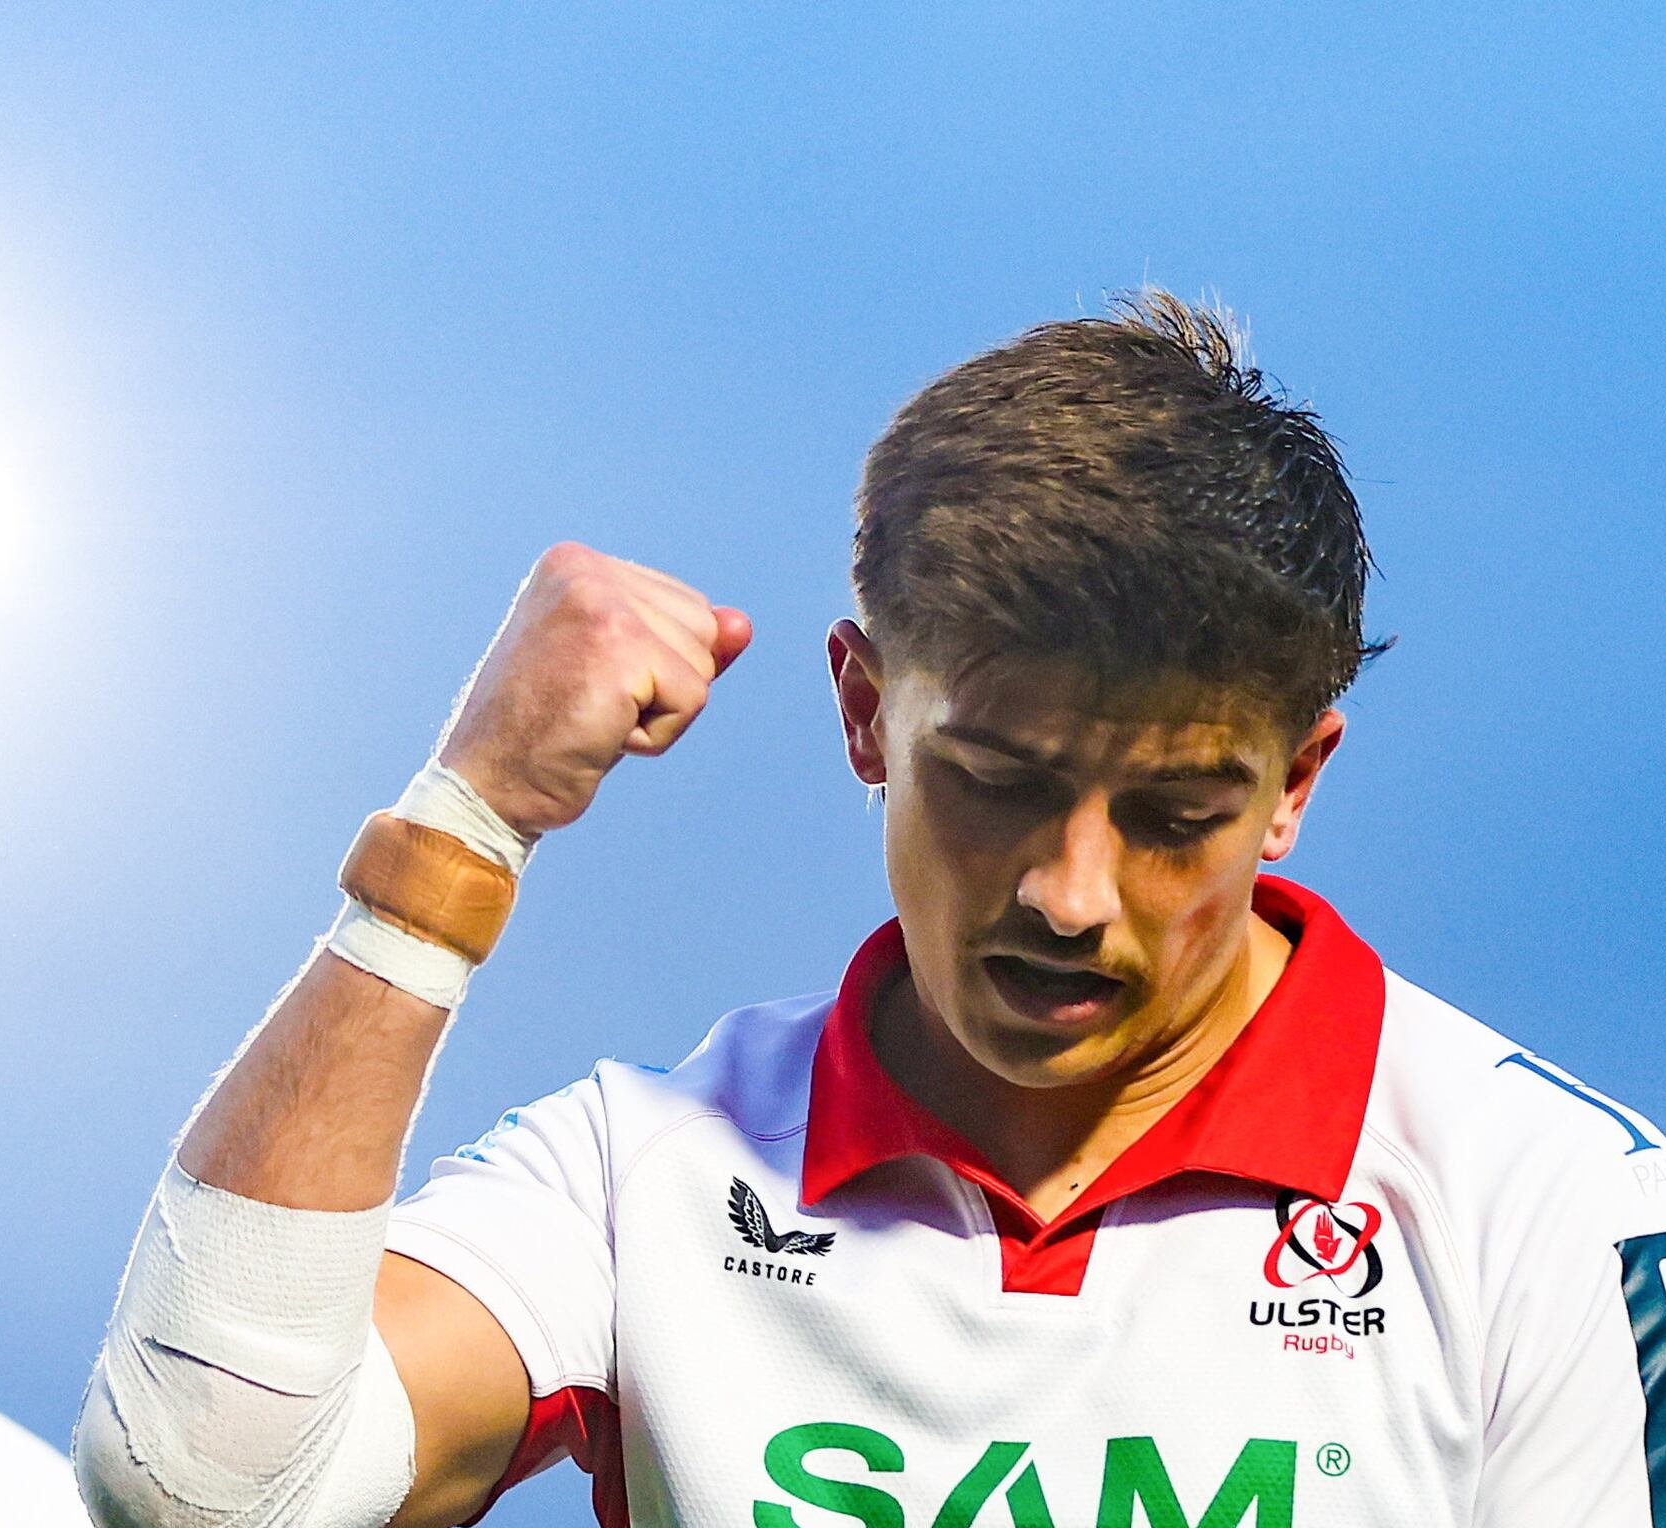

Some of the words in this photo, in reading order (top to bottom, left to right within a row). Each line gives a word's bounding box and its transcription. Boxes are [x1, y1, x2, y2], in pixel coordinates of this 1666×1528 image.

[724, 1256, 817, 1286] CASTORE
[1250, 1299, 1386, 1336] ULSTER
[1284, 1334, 1355, 1360] Rugby
